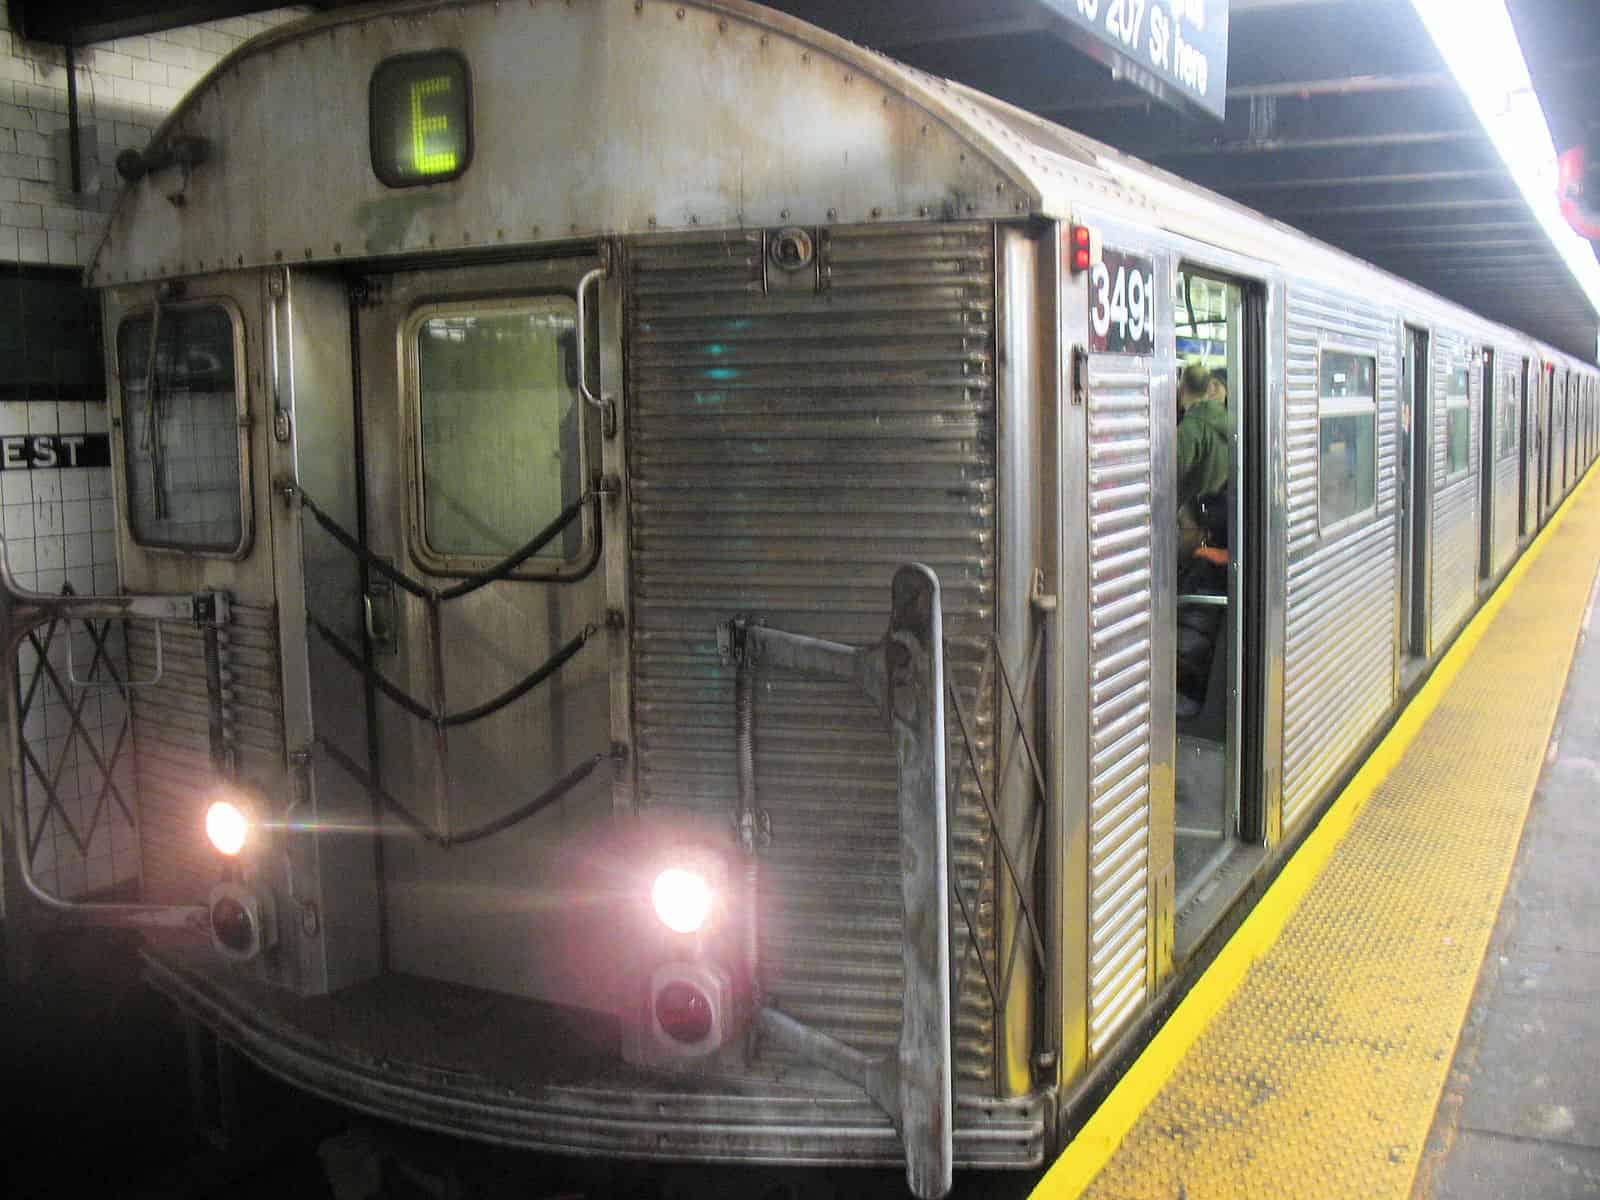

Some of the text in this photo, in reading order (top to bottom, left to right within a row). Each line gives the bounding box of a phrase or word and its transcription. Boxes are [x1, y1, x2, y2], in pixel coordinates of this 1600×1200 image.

[1105, 0, 1145, 49] 207
[1150, 5, 1169, 70] St
[410, 76, 457, 174] E
[1091, 261, 1154, 343] 3491
[2, 436, 85, 468] EST
